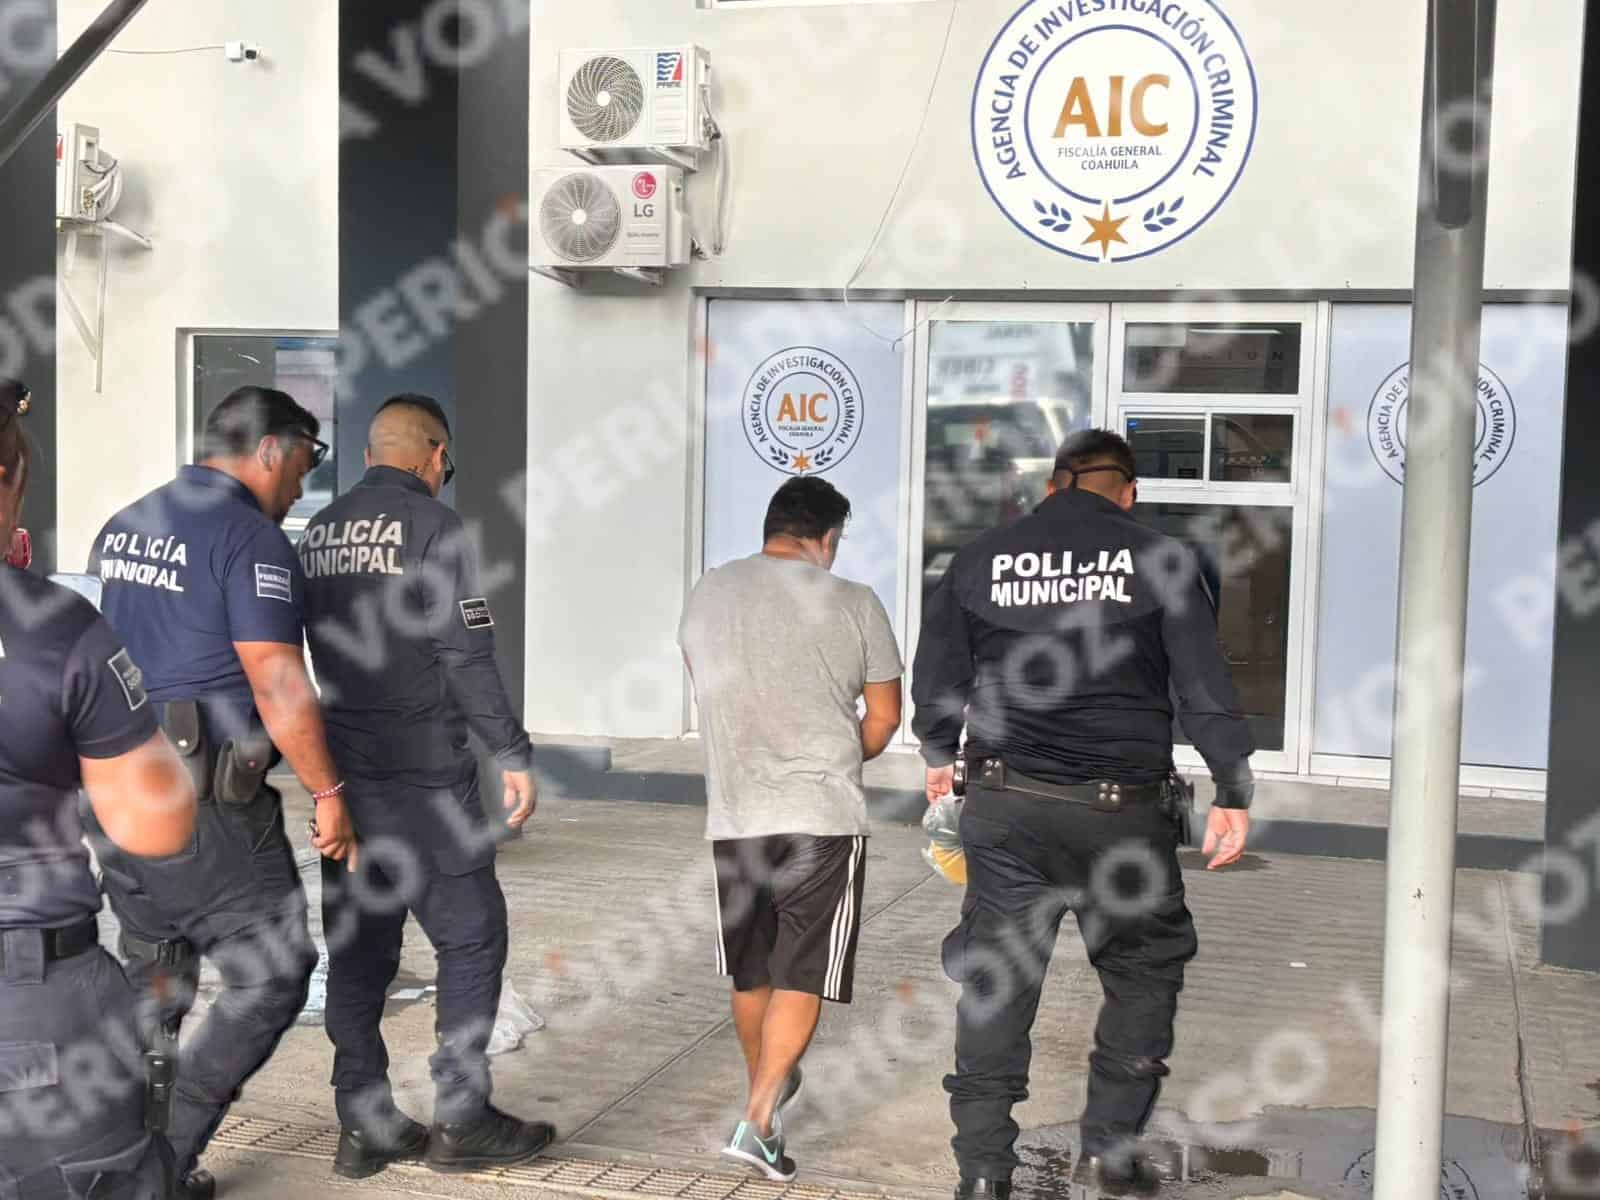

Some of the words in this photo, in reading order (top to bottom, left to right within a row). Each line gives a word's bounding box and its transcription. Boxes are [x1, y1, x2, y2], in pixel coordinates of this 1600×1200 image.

[1008, 35, 1040, 70] DE
[1051, 73, 1170, 139] AIC
[1192, 53, 1234, 177] CRIMINAL
[991, 73, 1026, 180] AGENCIA
[1057, 143, 1107, 158] FISCALÍA
[1110, 145, 1162, 157] GENERAL
[1080, 159, 1139, 170] COAHUILA
[633, 203, 654, 218] LG
[756, 376, 770, 392] DE
[1385, 384, 1403, 403] DE
[750, 393, 769, 442] AGENCIA
[776, 392, 829, 424] AIC
[835, 388, 855, 444] CRIMINAL
[1377, 405, 1399, 459] AGENCIA
[1480, 399, 1505, 461] CRIMINAL
[103, 532, 187, 567] POLICÍA
[300, 546, 403, 579] UNICIPAL
[991, 575, 1132, 607] MUNICIPAL
